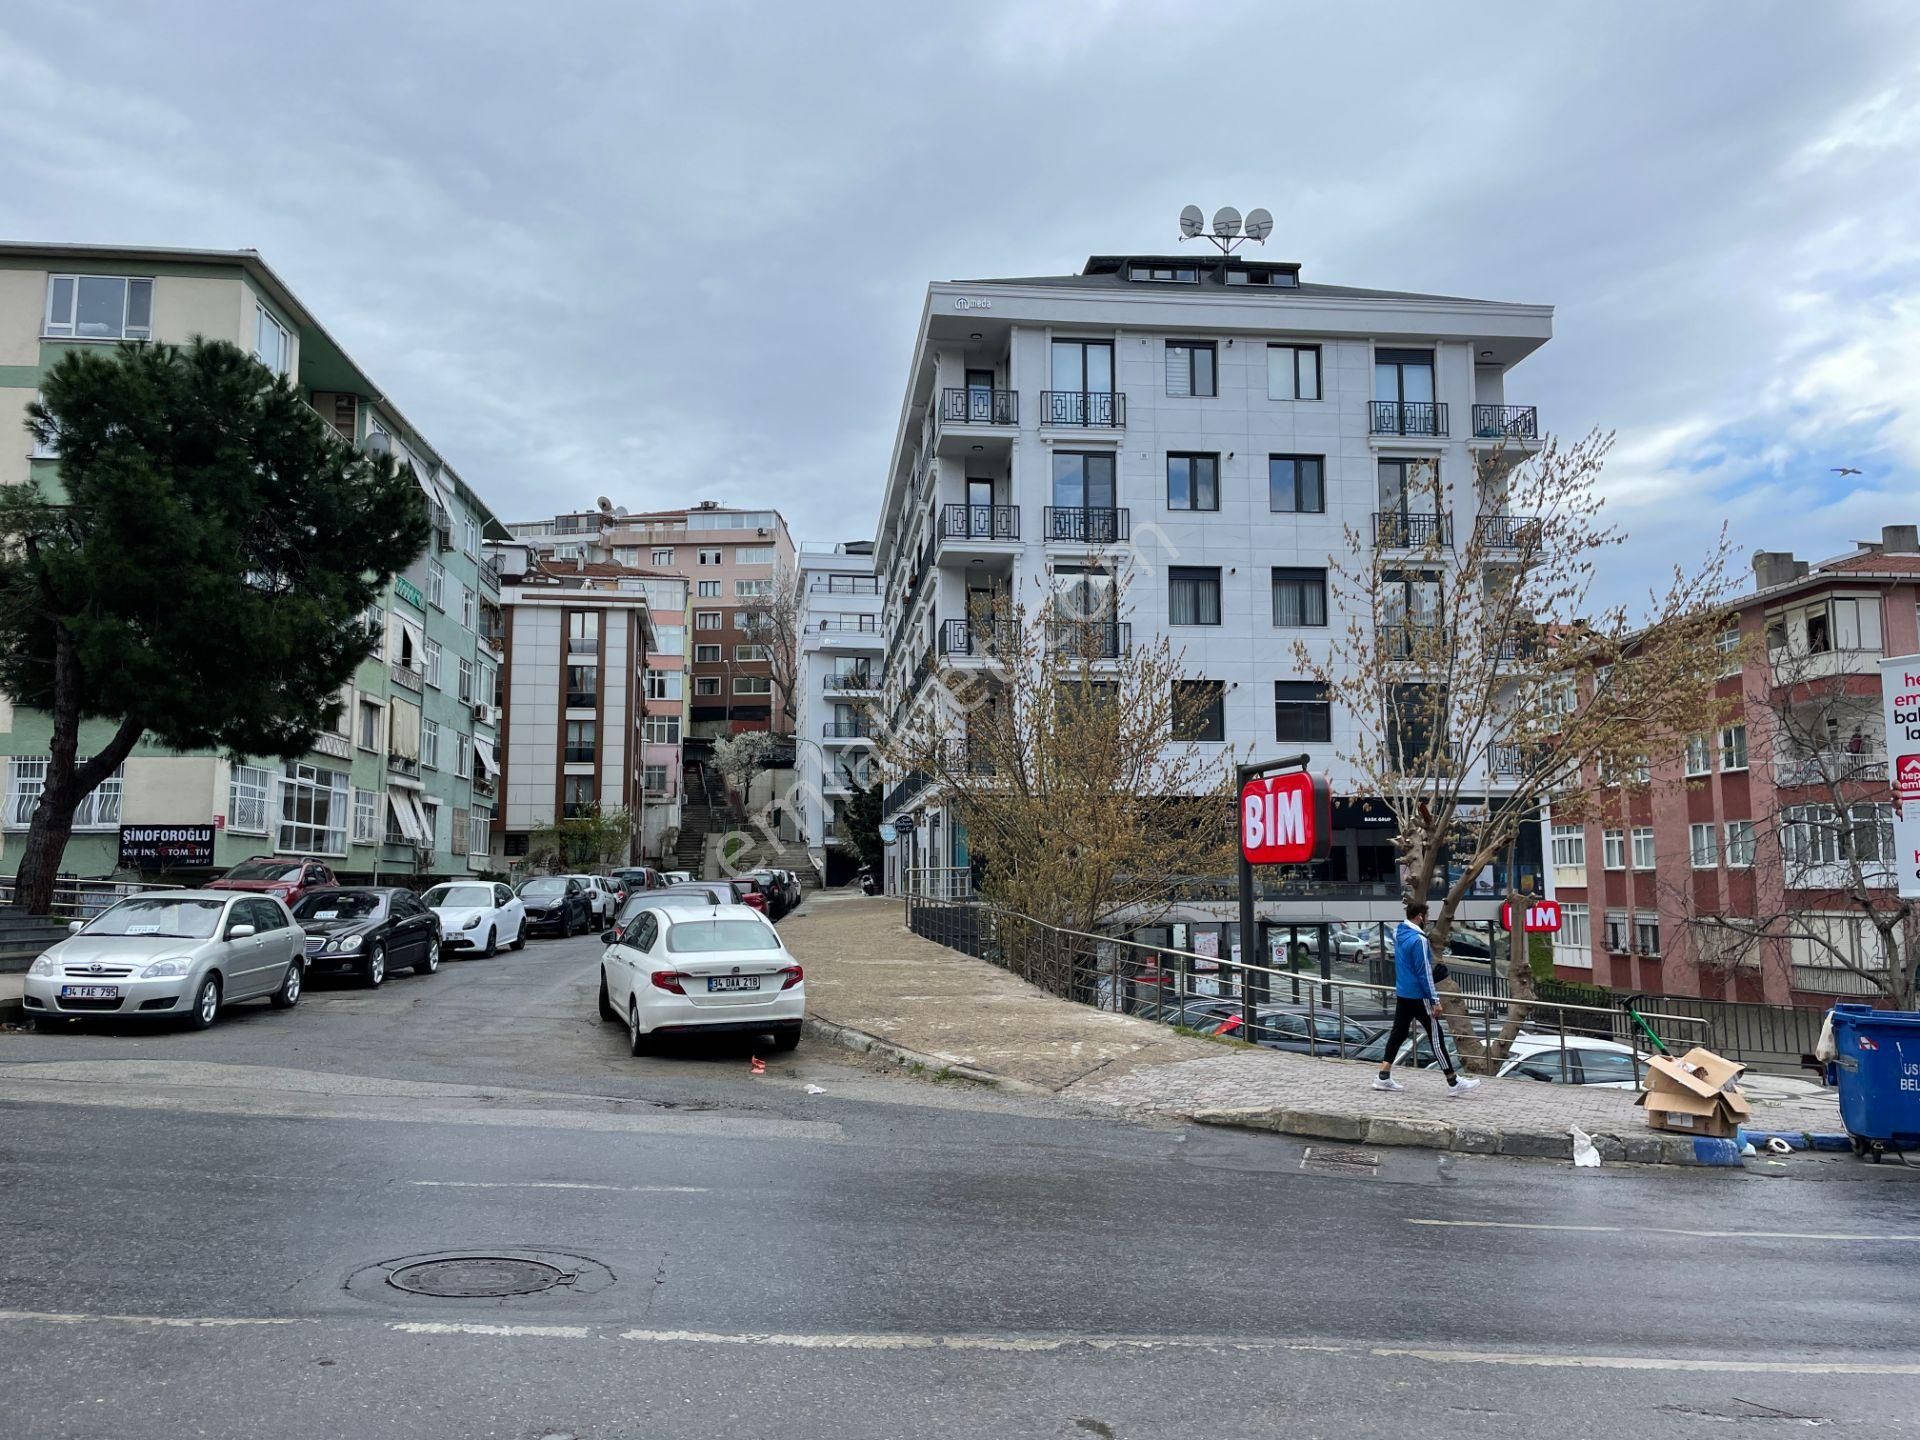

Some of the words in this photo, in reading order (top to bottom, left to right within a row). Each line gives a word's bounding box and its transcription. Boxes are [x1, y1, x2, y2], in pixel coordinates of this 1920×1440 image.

[123, 827, 210, 845] ŞİNOFOROĞLU
[713, 978, 723, 988] 34
[67, 987, 77, 996] 34
[81, 987, 96, 997] FAE
[101, 988, 116, 997] 795
